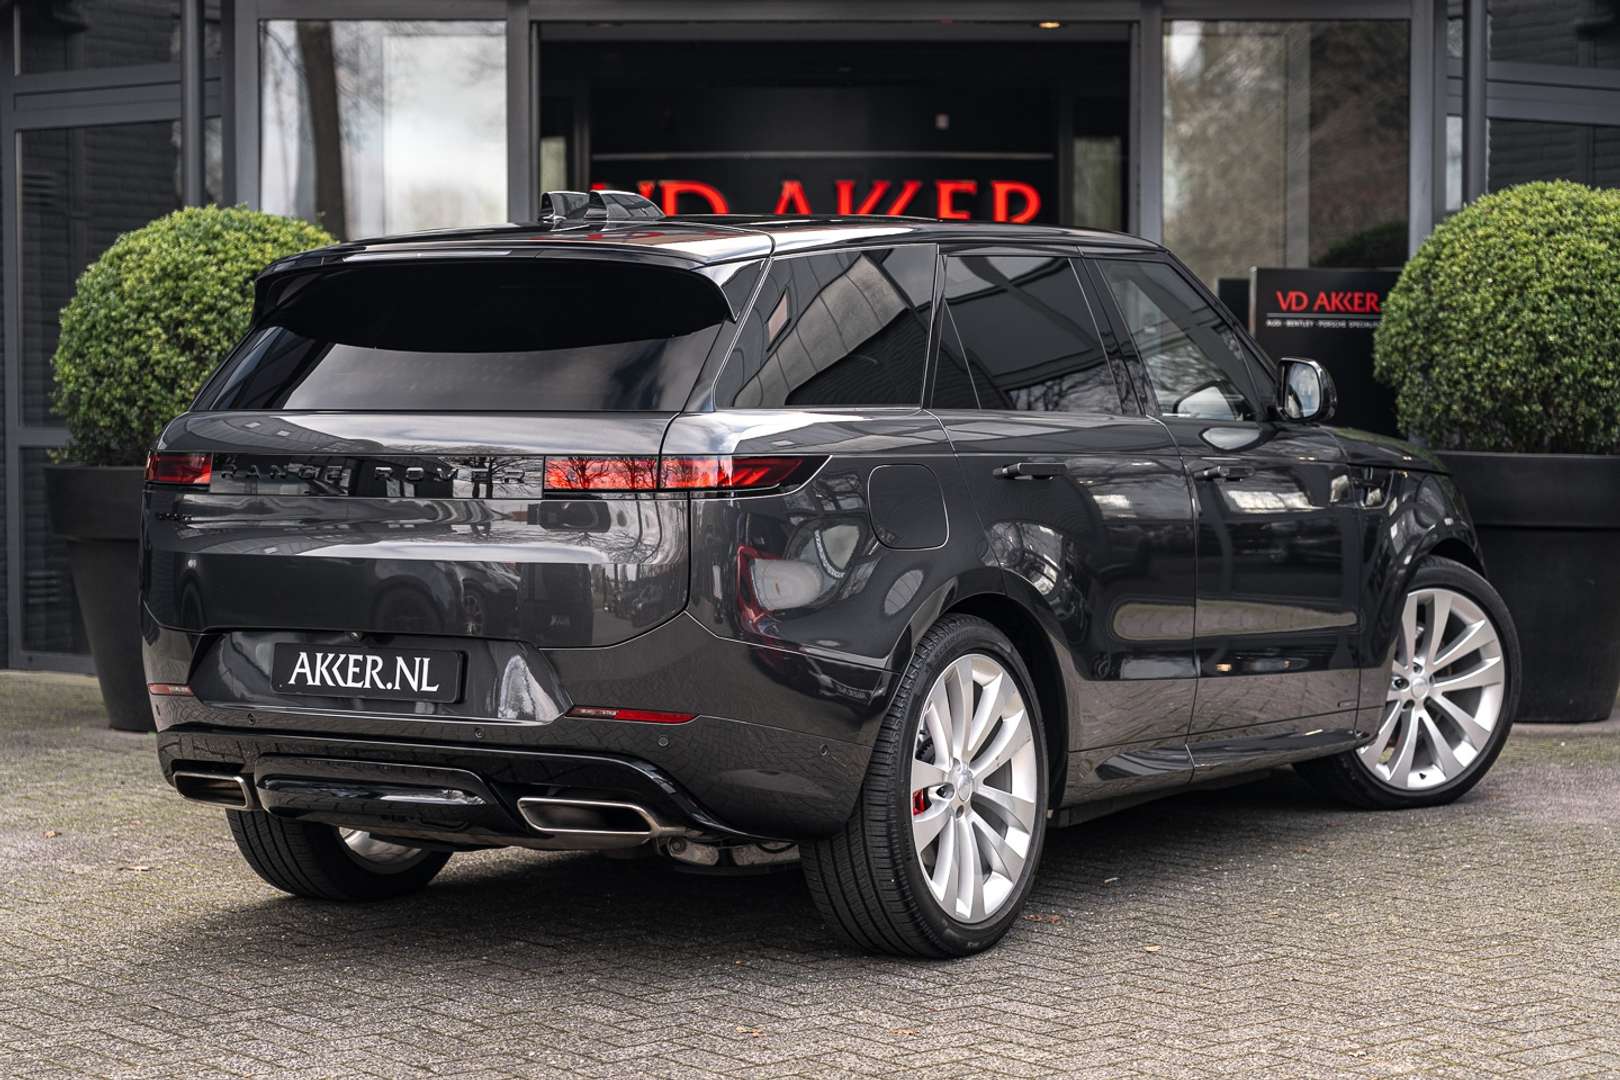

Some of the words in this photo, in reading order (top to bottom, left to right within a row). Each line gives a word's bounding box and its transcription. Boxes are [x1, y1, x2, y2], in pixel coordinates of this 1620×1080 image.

[1276, 290, 1309, 312] VD
[1312, 290, 1380, 313] AKKER
[375, 466, 526, 485] ROVER
[288, 651, 440, 692] AKKER.NL
